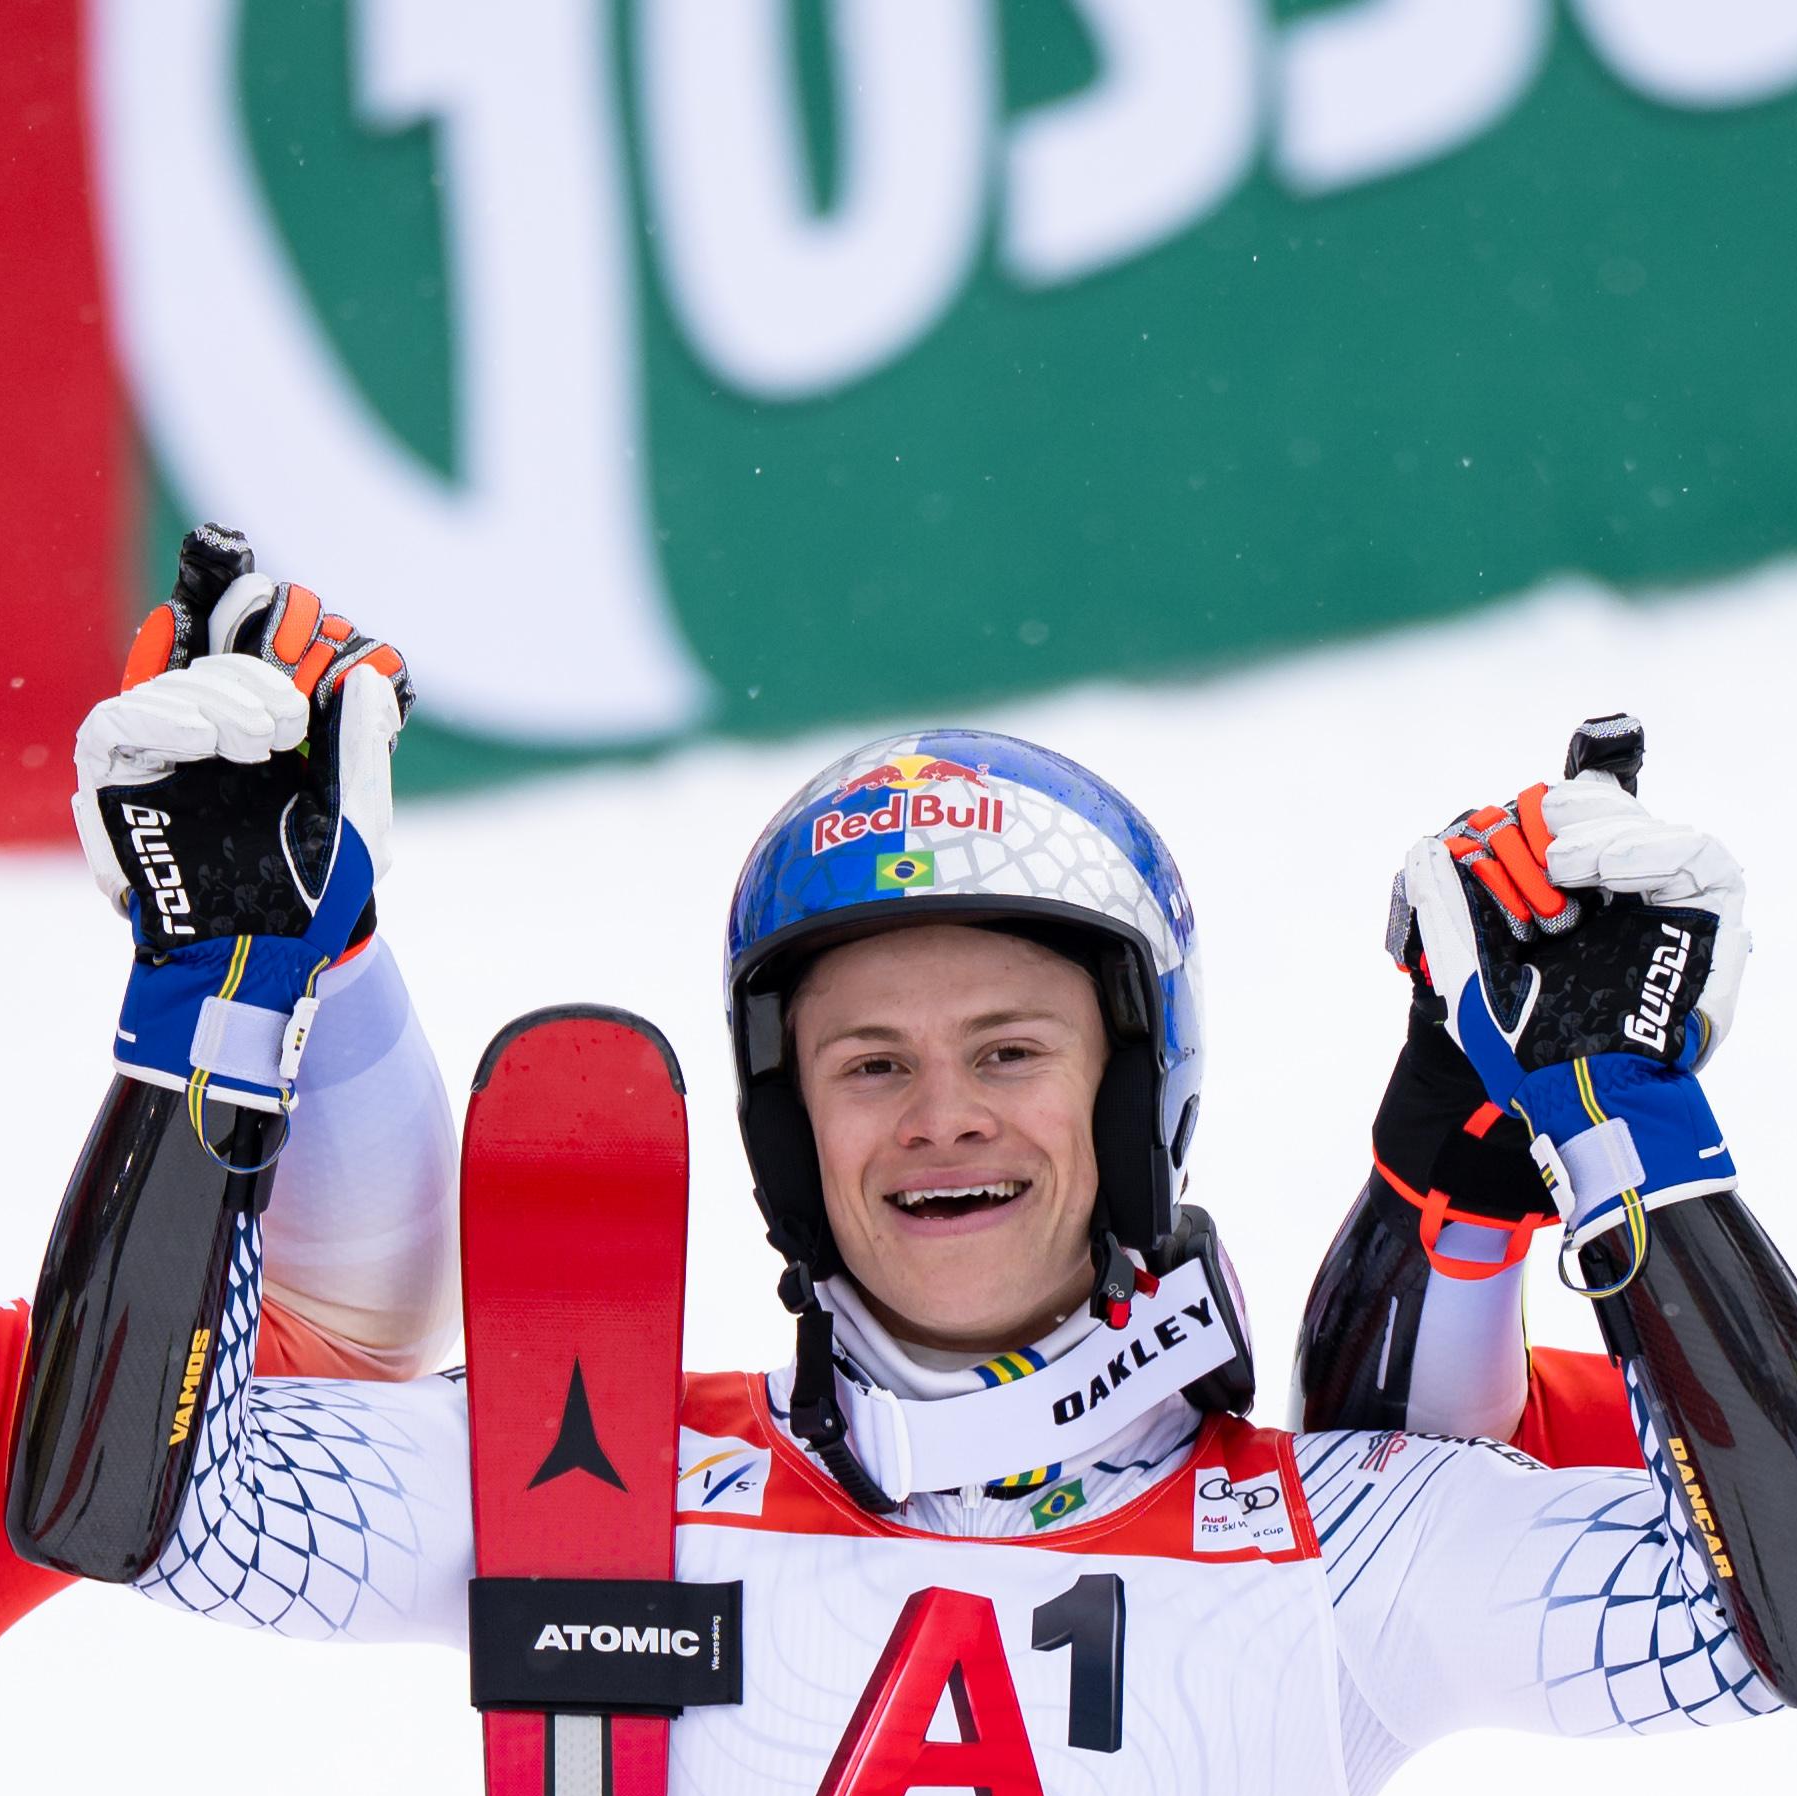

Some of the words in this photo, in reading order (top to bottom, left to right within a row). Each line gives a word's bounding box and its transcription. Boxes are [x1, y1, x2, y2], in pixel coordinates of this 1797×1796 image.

[120, 802, 196, 936] racing
[813, 794, 904, 855] Red
[910, 793, 1003, 833] Bull
[1624, 923, 1692, 1053] racing
[169, 1328, 211, 1446] VAMOS
[1053, 1297, 1216, 1427] OAKLEY
[1201, 1515, 1228, 1523] Audi
[1201, 1524, 1219, 1533] FIS
[1668, 1437, 1734, 1579] DANÇAR
[534, 1623, 700, 1658] ATOMIC
